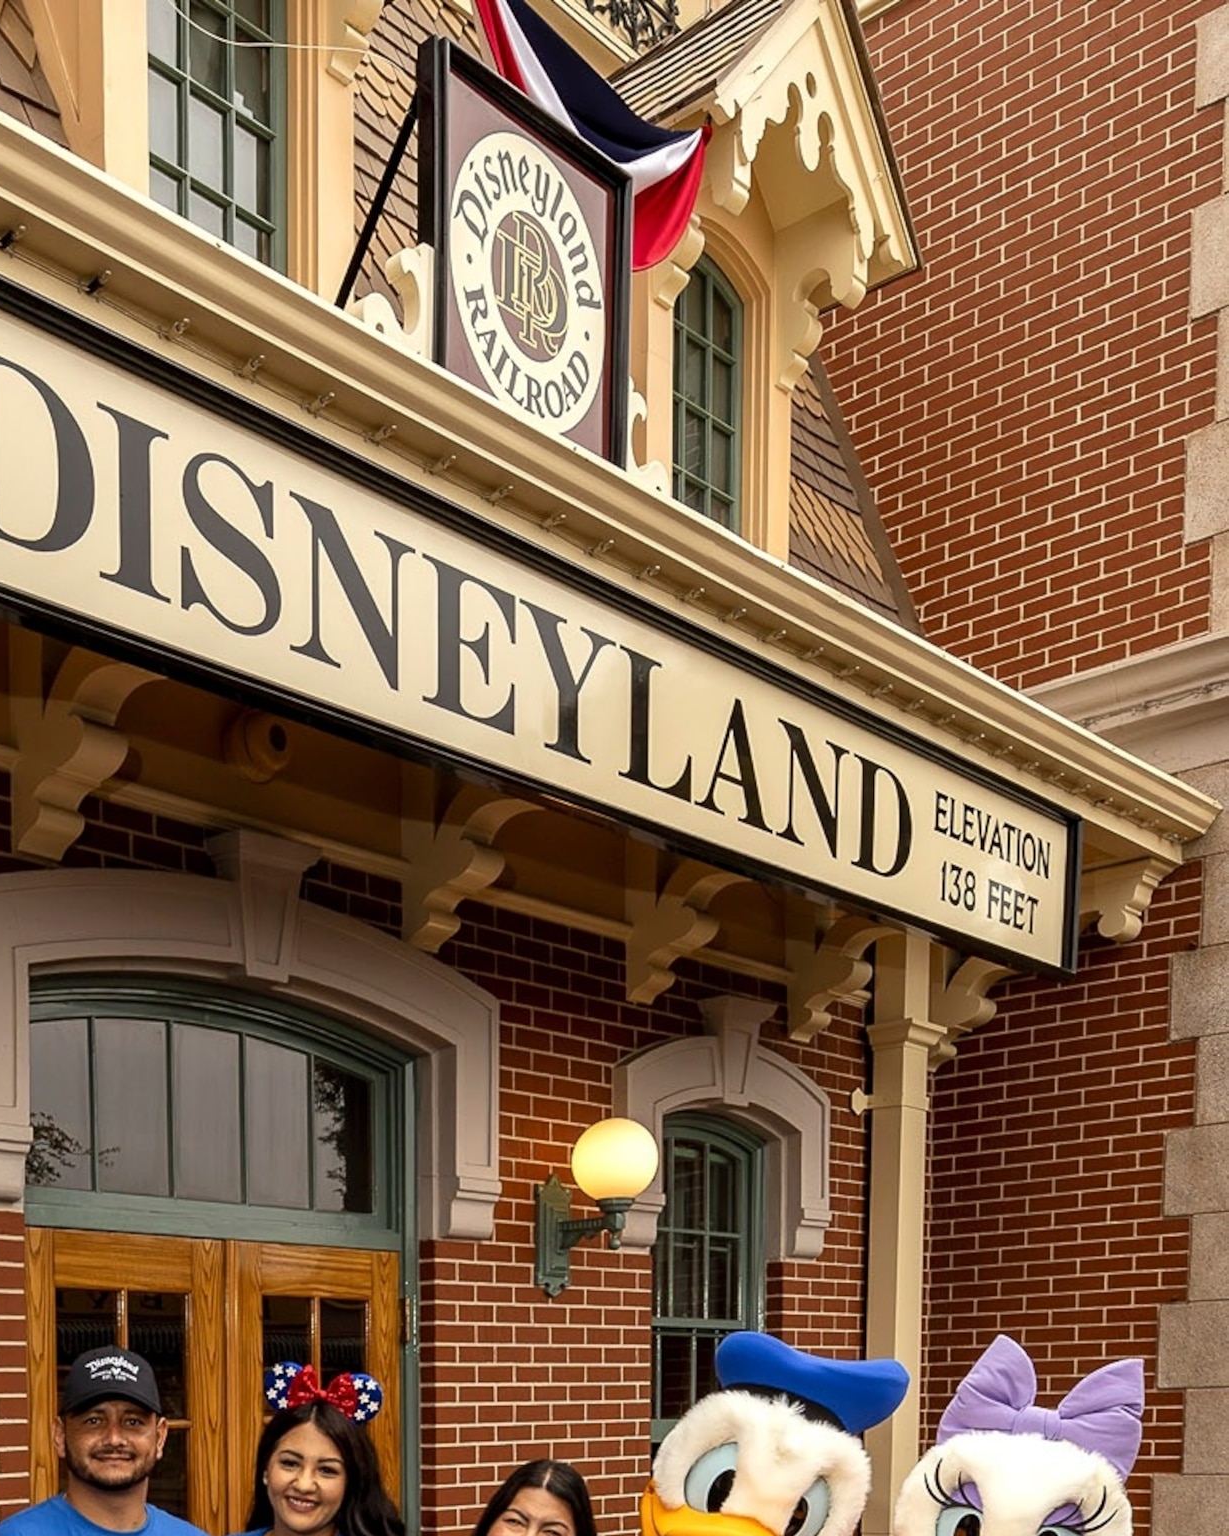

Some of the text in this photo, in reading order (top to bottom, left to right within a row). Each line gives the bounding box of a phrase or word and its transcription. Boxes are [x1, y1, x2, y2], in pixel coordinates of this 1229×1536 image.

[453, 149, 602, 311] Disneyland
[463, 285, 591, 420] RAILROAD
[934, 791, 1050, 879] ELEVATION
[940, 860, 1040, 935] 138 FEET
